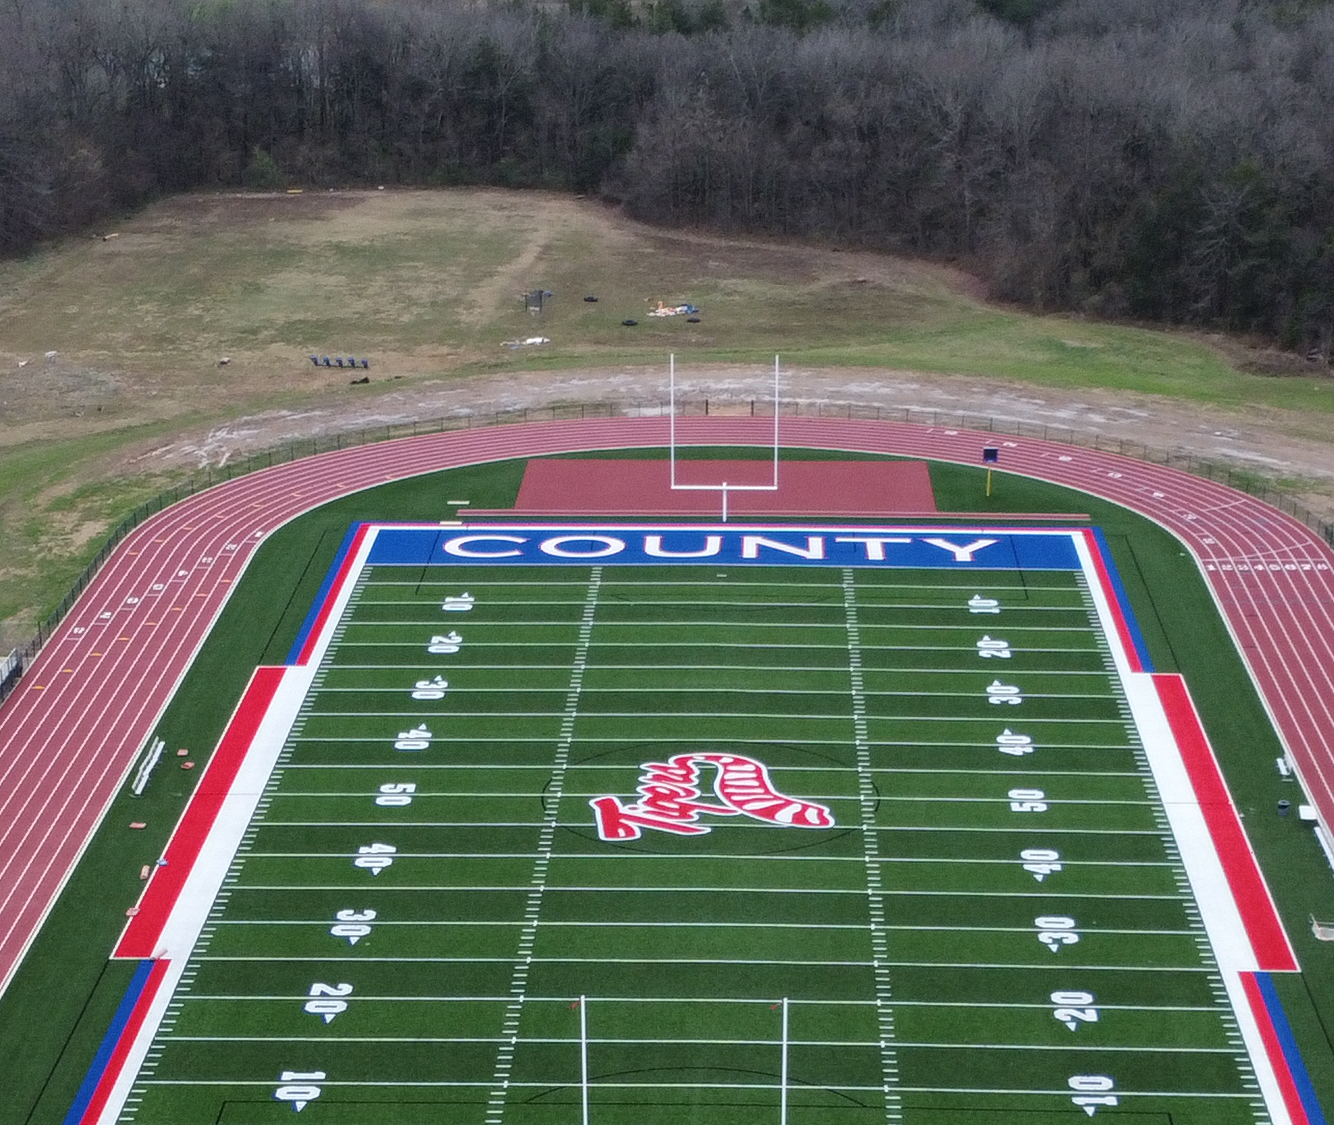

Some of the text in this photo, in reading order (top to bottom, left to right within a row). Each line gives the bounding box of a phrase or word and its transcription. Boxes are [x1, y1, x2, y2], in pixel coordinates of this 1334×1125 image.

[442, 535, 999, 562] COUNTY
[442, 596, 475, 612] 10
[968, 598, 1001, 614] 10
[427, 635, 463, 654] 20
[976, 640, 1012, 659] 20
[411, 680, 449, 700] 30
[986, 685, 1022, 705] 30
[394, 729, 432, 751] 40
[996, 735, 1034, 756] 40
[375, 783, 416, 806] 50
[1008, 789, 1048, 812] 50
[353, 843, 397, 868] 40
[1020, 849, 1062, 875] 40
[330, 909, 377, 937] 30
[1034, 916, 1080, 945] 30
[304, 982, 354, 1014] 20
[1050, 991, 1098, 1022] 20
[274, 1071, 327, 1101] 10
[1068, 1075, 1118, 1106] 10
